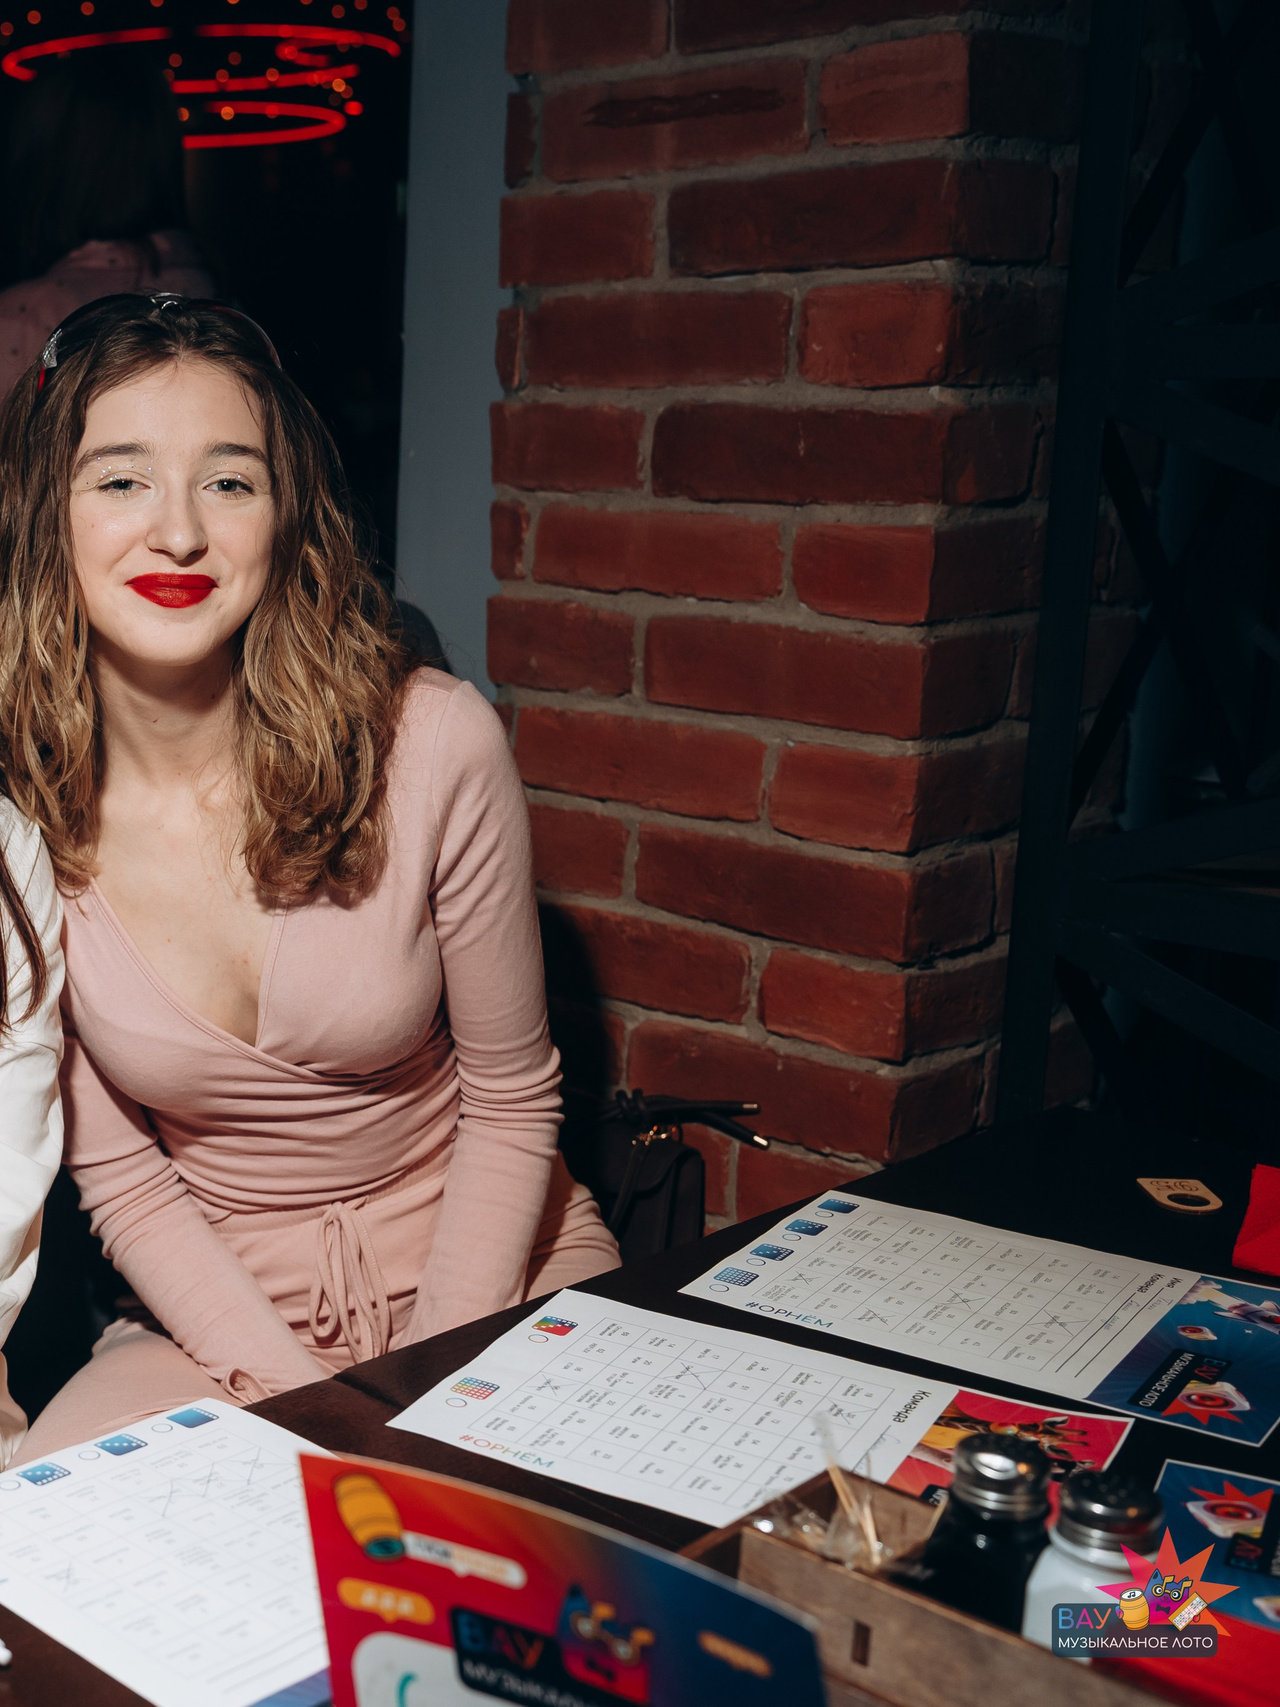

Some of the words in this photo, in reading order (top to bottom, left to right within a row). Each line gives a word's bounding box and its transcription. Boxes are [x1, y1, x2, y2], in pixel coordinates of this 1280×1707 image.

[745, 1301, 834, 1328] #ОРНЁМ
[1152, 1352, 1195, 1394] МУЗЫКАЛЬНОЕ
[892, 1390, 932, 1423] Команда
[1138, 1390, 1161, 1408] ЛОТО
[459, 1434, 555, 1468] #ОРНЁМ
